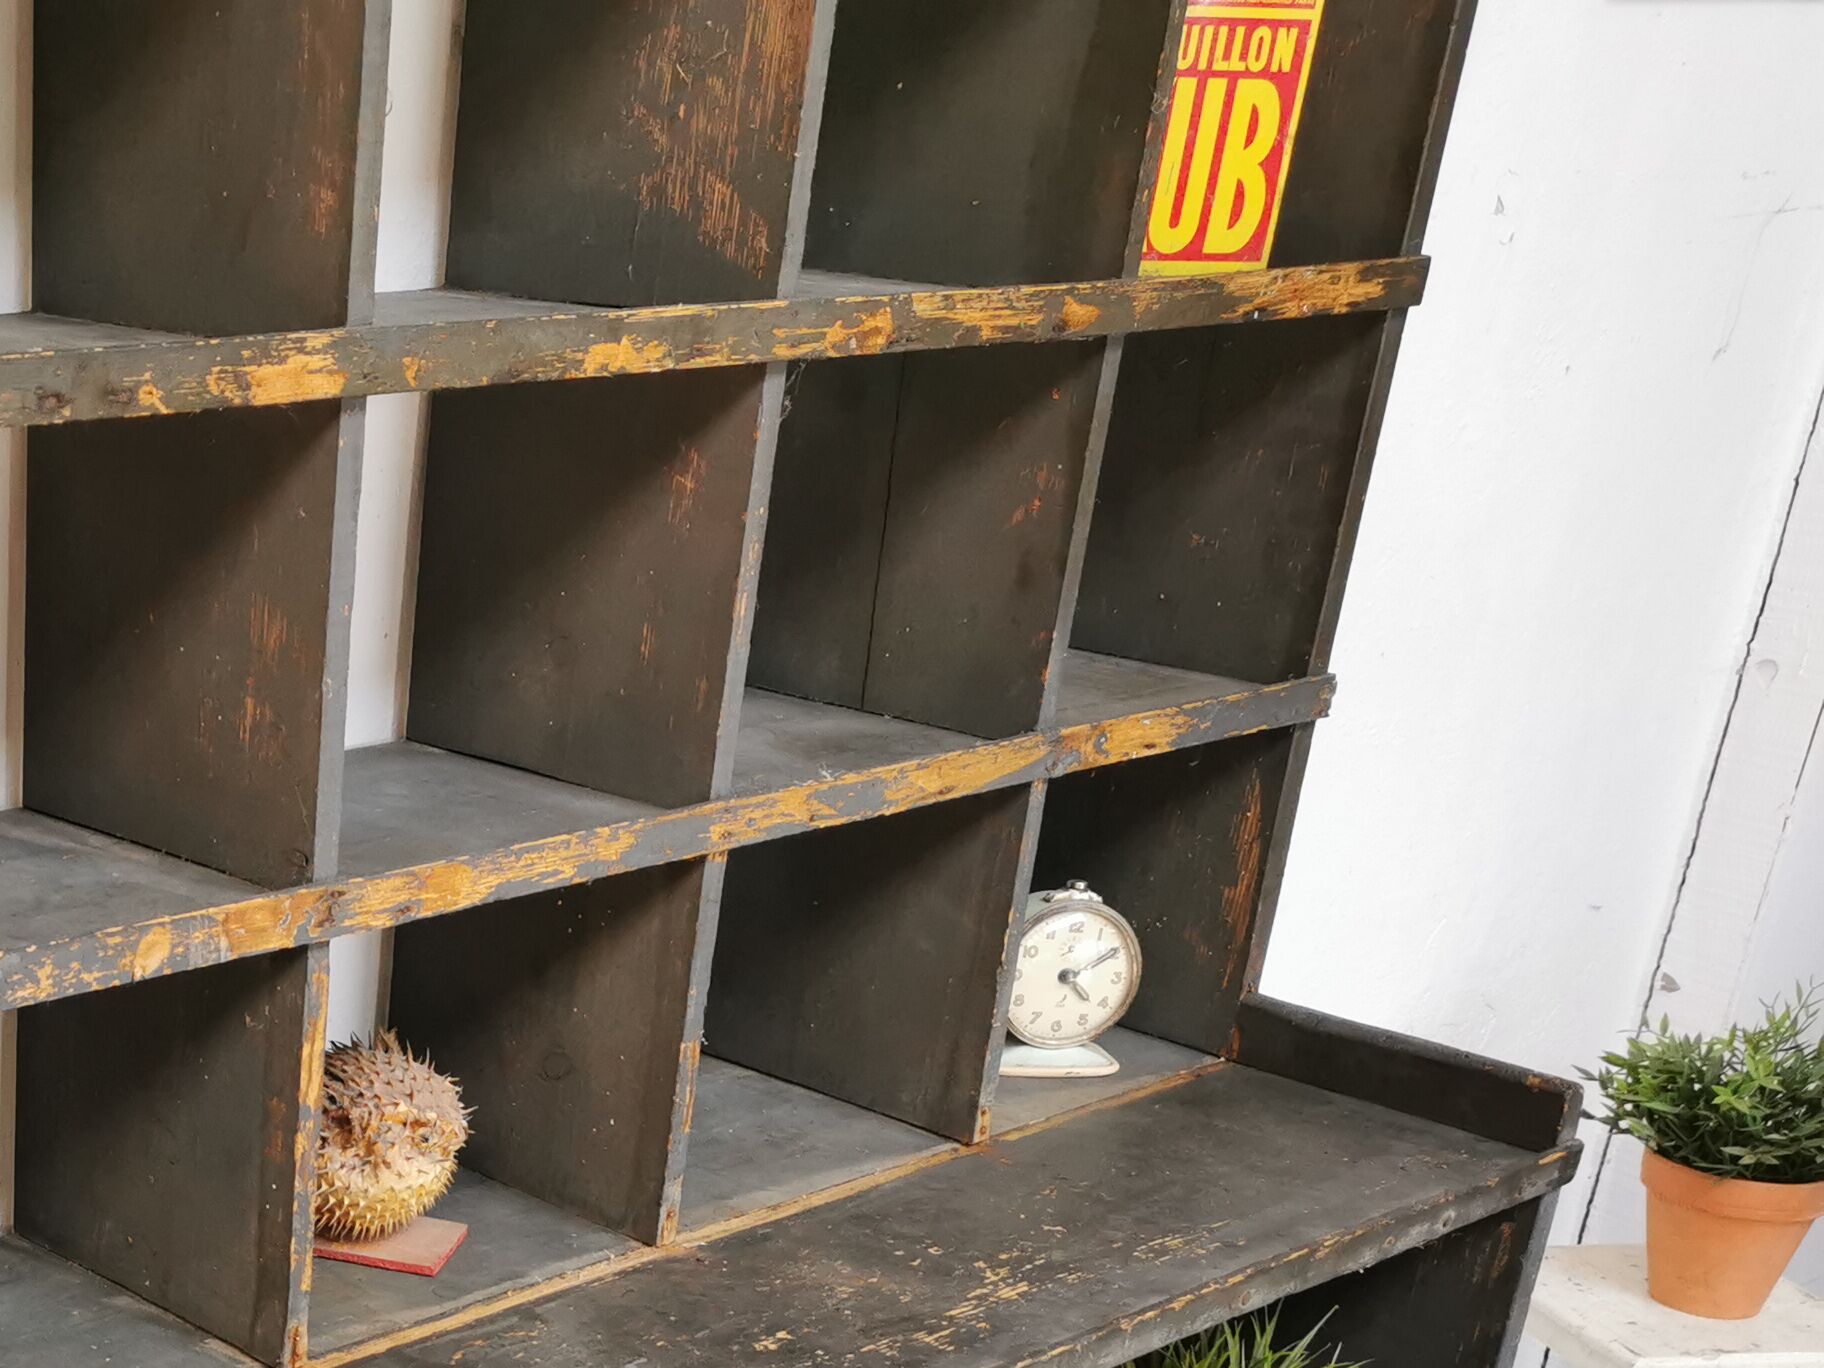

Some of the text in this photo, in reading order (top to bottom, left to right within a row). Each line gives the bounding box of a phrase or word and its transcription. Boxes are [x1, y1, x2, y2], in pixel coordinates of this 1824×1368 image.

[1177, 24, 1298, 73] UILLON
[1148, 76, 1281, 254] UB
[1013, 993, 1025, 1007] 8
[1029, 1011, 1043, 1025] 7
[1077, 1013, 1089, 1027] 5
[1050, 1019, 1063, 1033] 6
